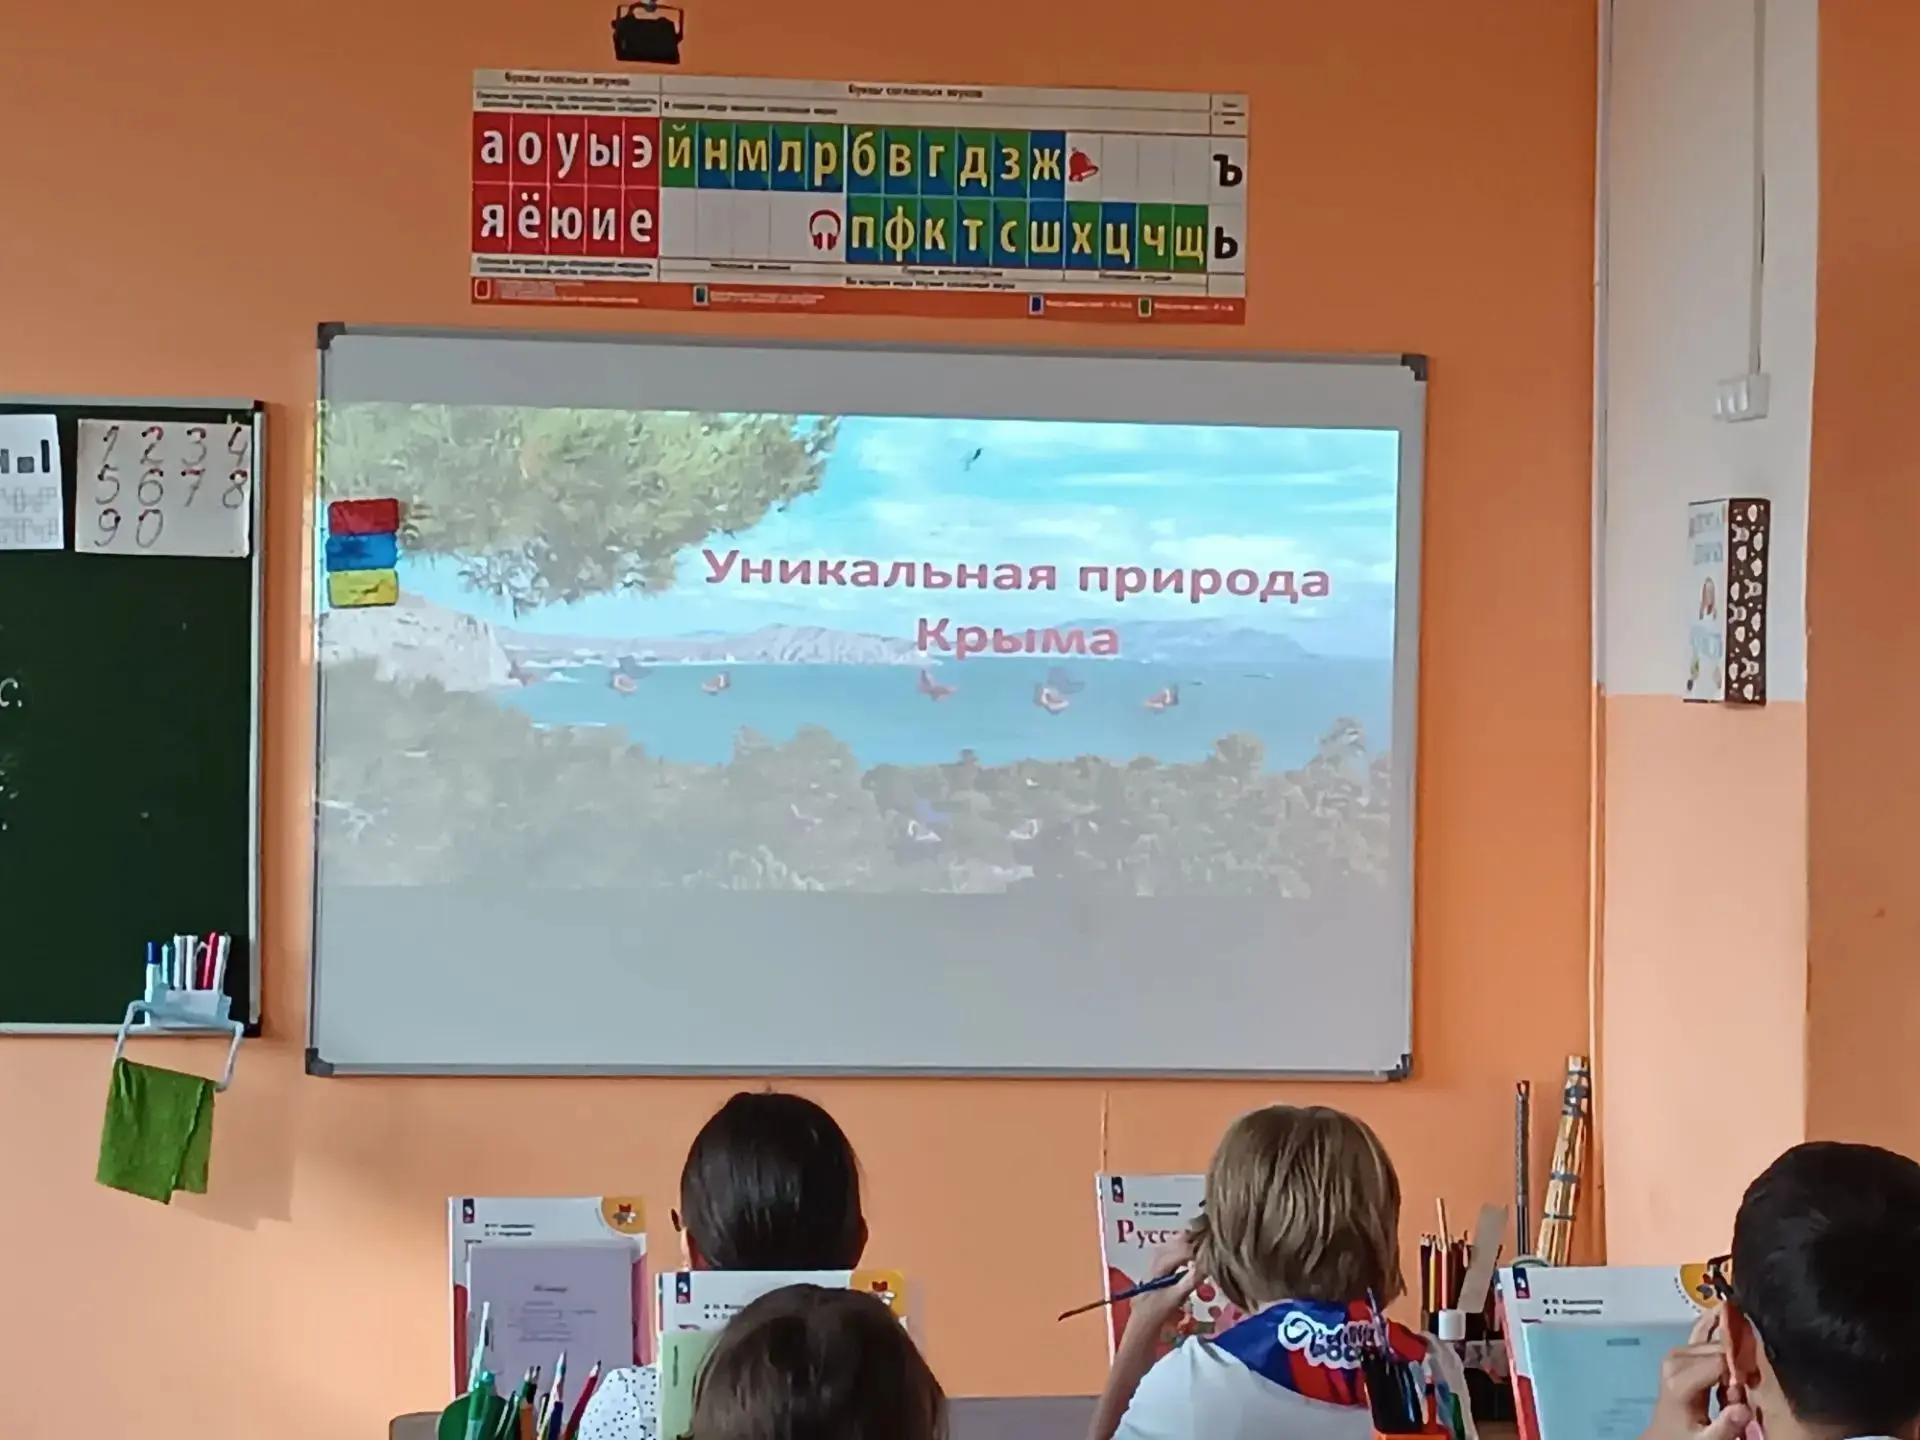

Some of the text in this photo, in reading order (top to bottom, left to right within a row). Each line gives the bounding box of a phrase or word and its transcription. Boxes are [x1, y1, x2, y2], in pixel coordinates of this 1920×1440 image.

[481, 130, 652, 179] а о у ы э
[668, 123, 837, 186] й н м л р
[851, 131, 1060, 188] б в г д з ж
[481, 192, 652, 242] я ё ю и е
[851, 205, 1203, 265] п ф к т с ш х ц ч щ
[103, 425, 248, 466] 1 2 3 4
[96, 464, 248, 508] 5 6 7 8
[94, 508, 163, 548] 9 0
[702, 549, 1329, 604] Уникальная природа
[917, 617, 1118, 660] Крыма
[1117, 1219, 1180, 1249] Русс
